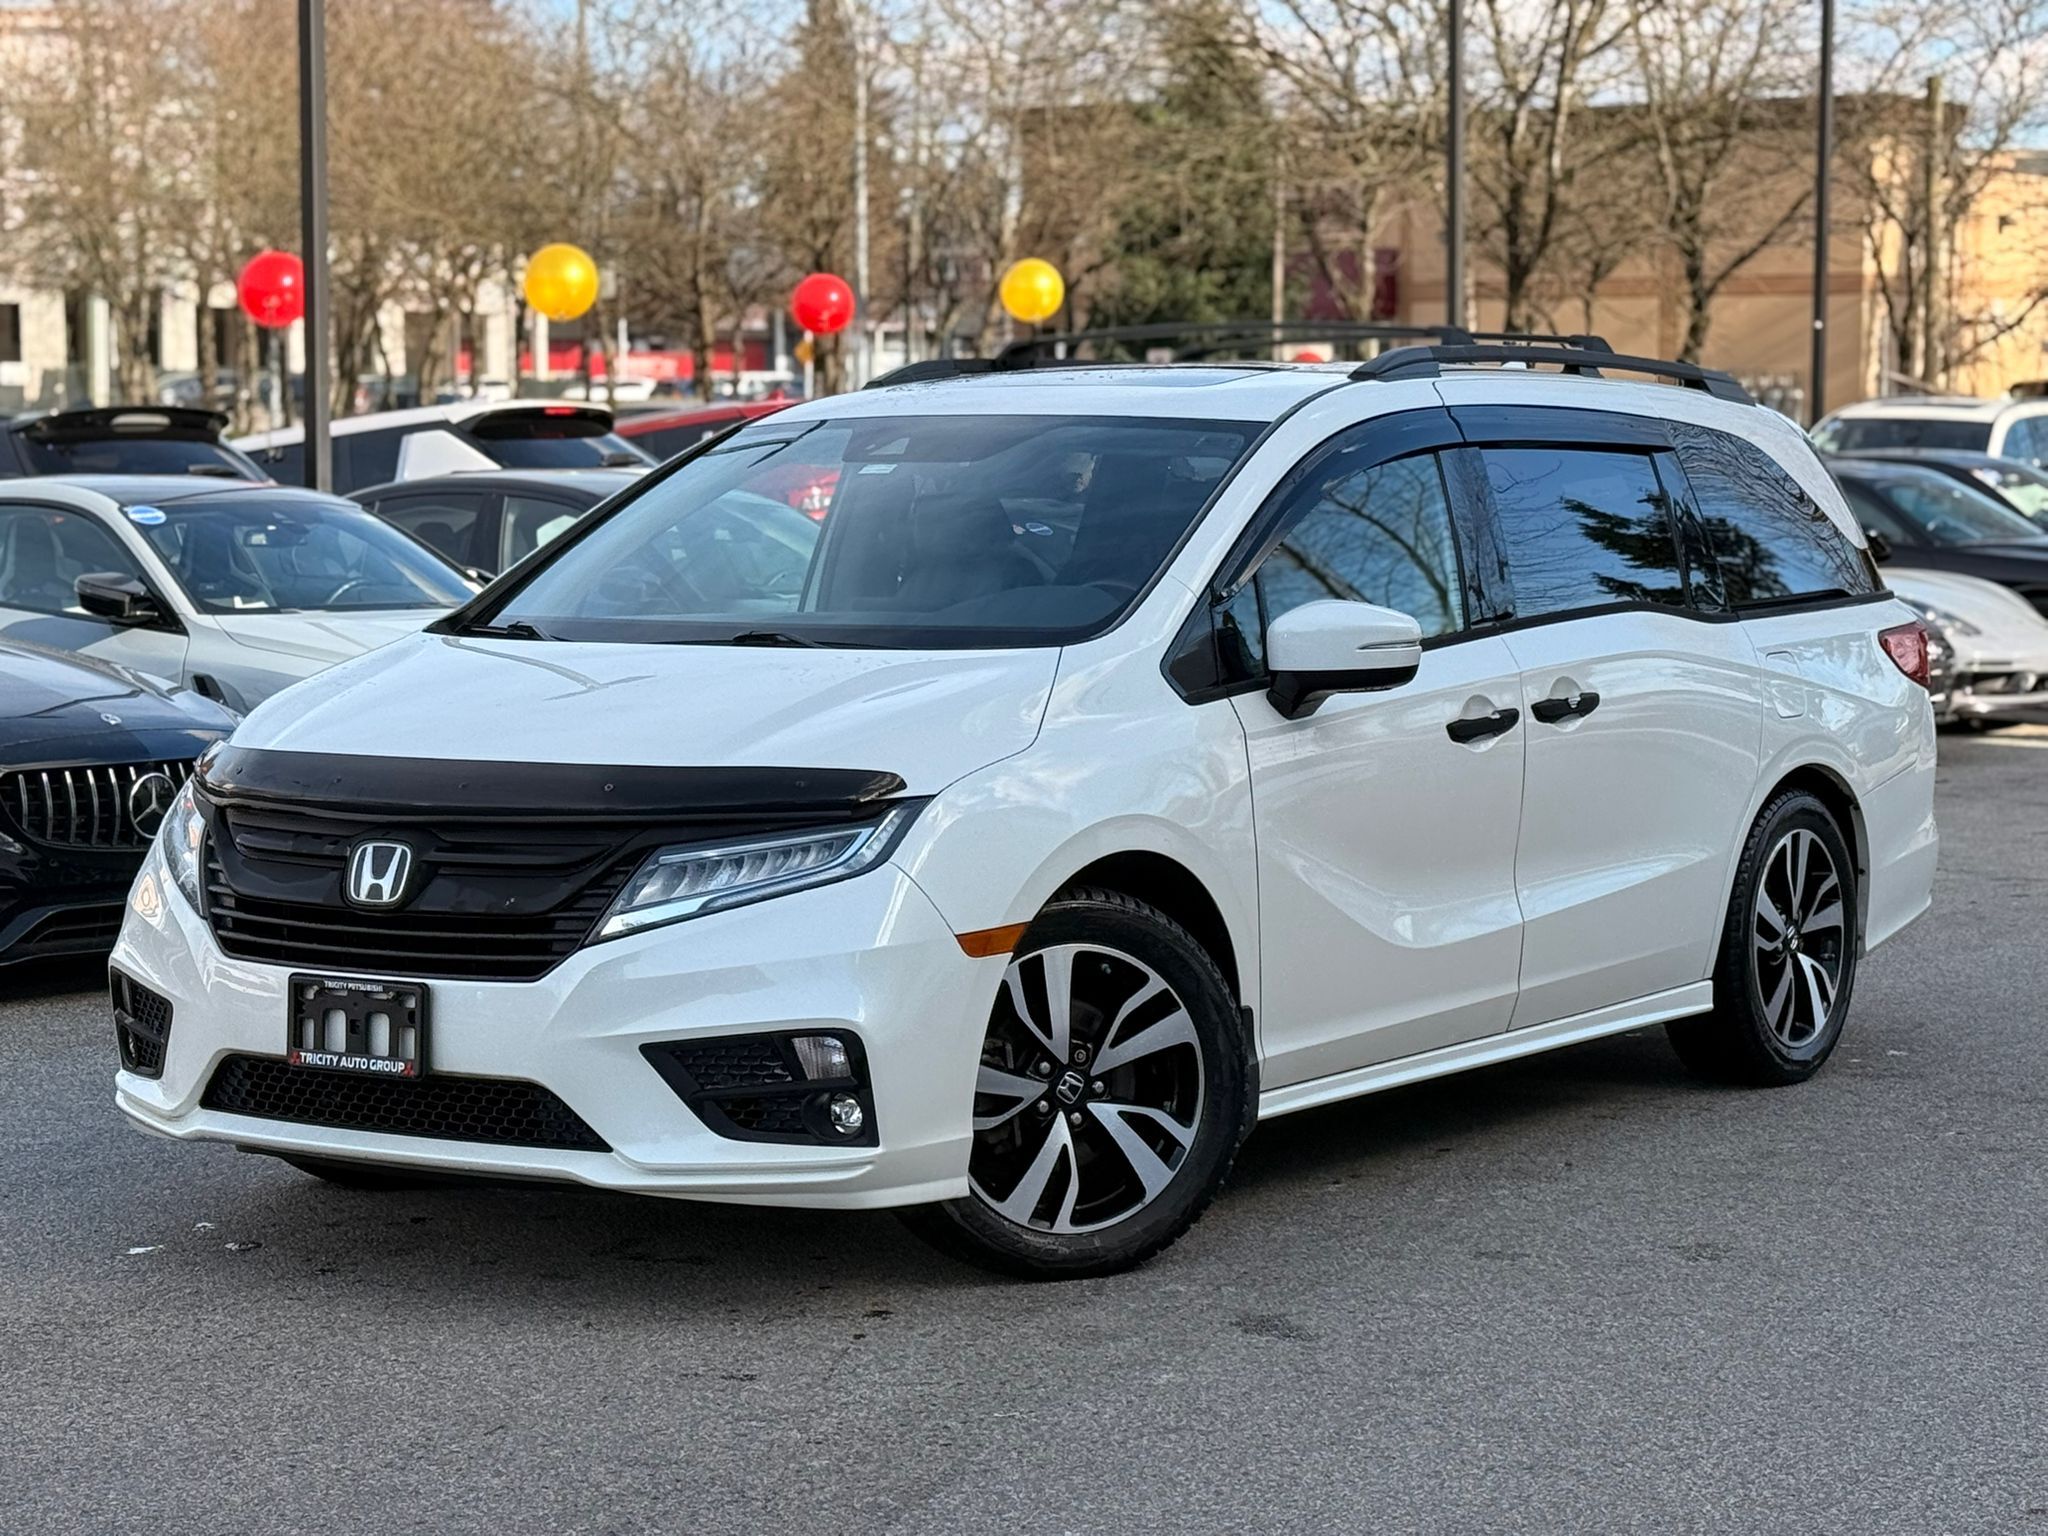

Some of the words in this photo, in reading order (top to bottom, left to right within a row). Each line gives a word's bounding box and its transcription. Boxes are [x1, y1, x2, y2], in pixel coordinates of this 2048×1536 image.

[323, 980, 347, 990] TRICITY
[299, 1051, 339, 1067] TRICITY
[340, 1056, 368, 1070] AUTO
[369, 1059, 406, 1074] GROUP
